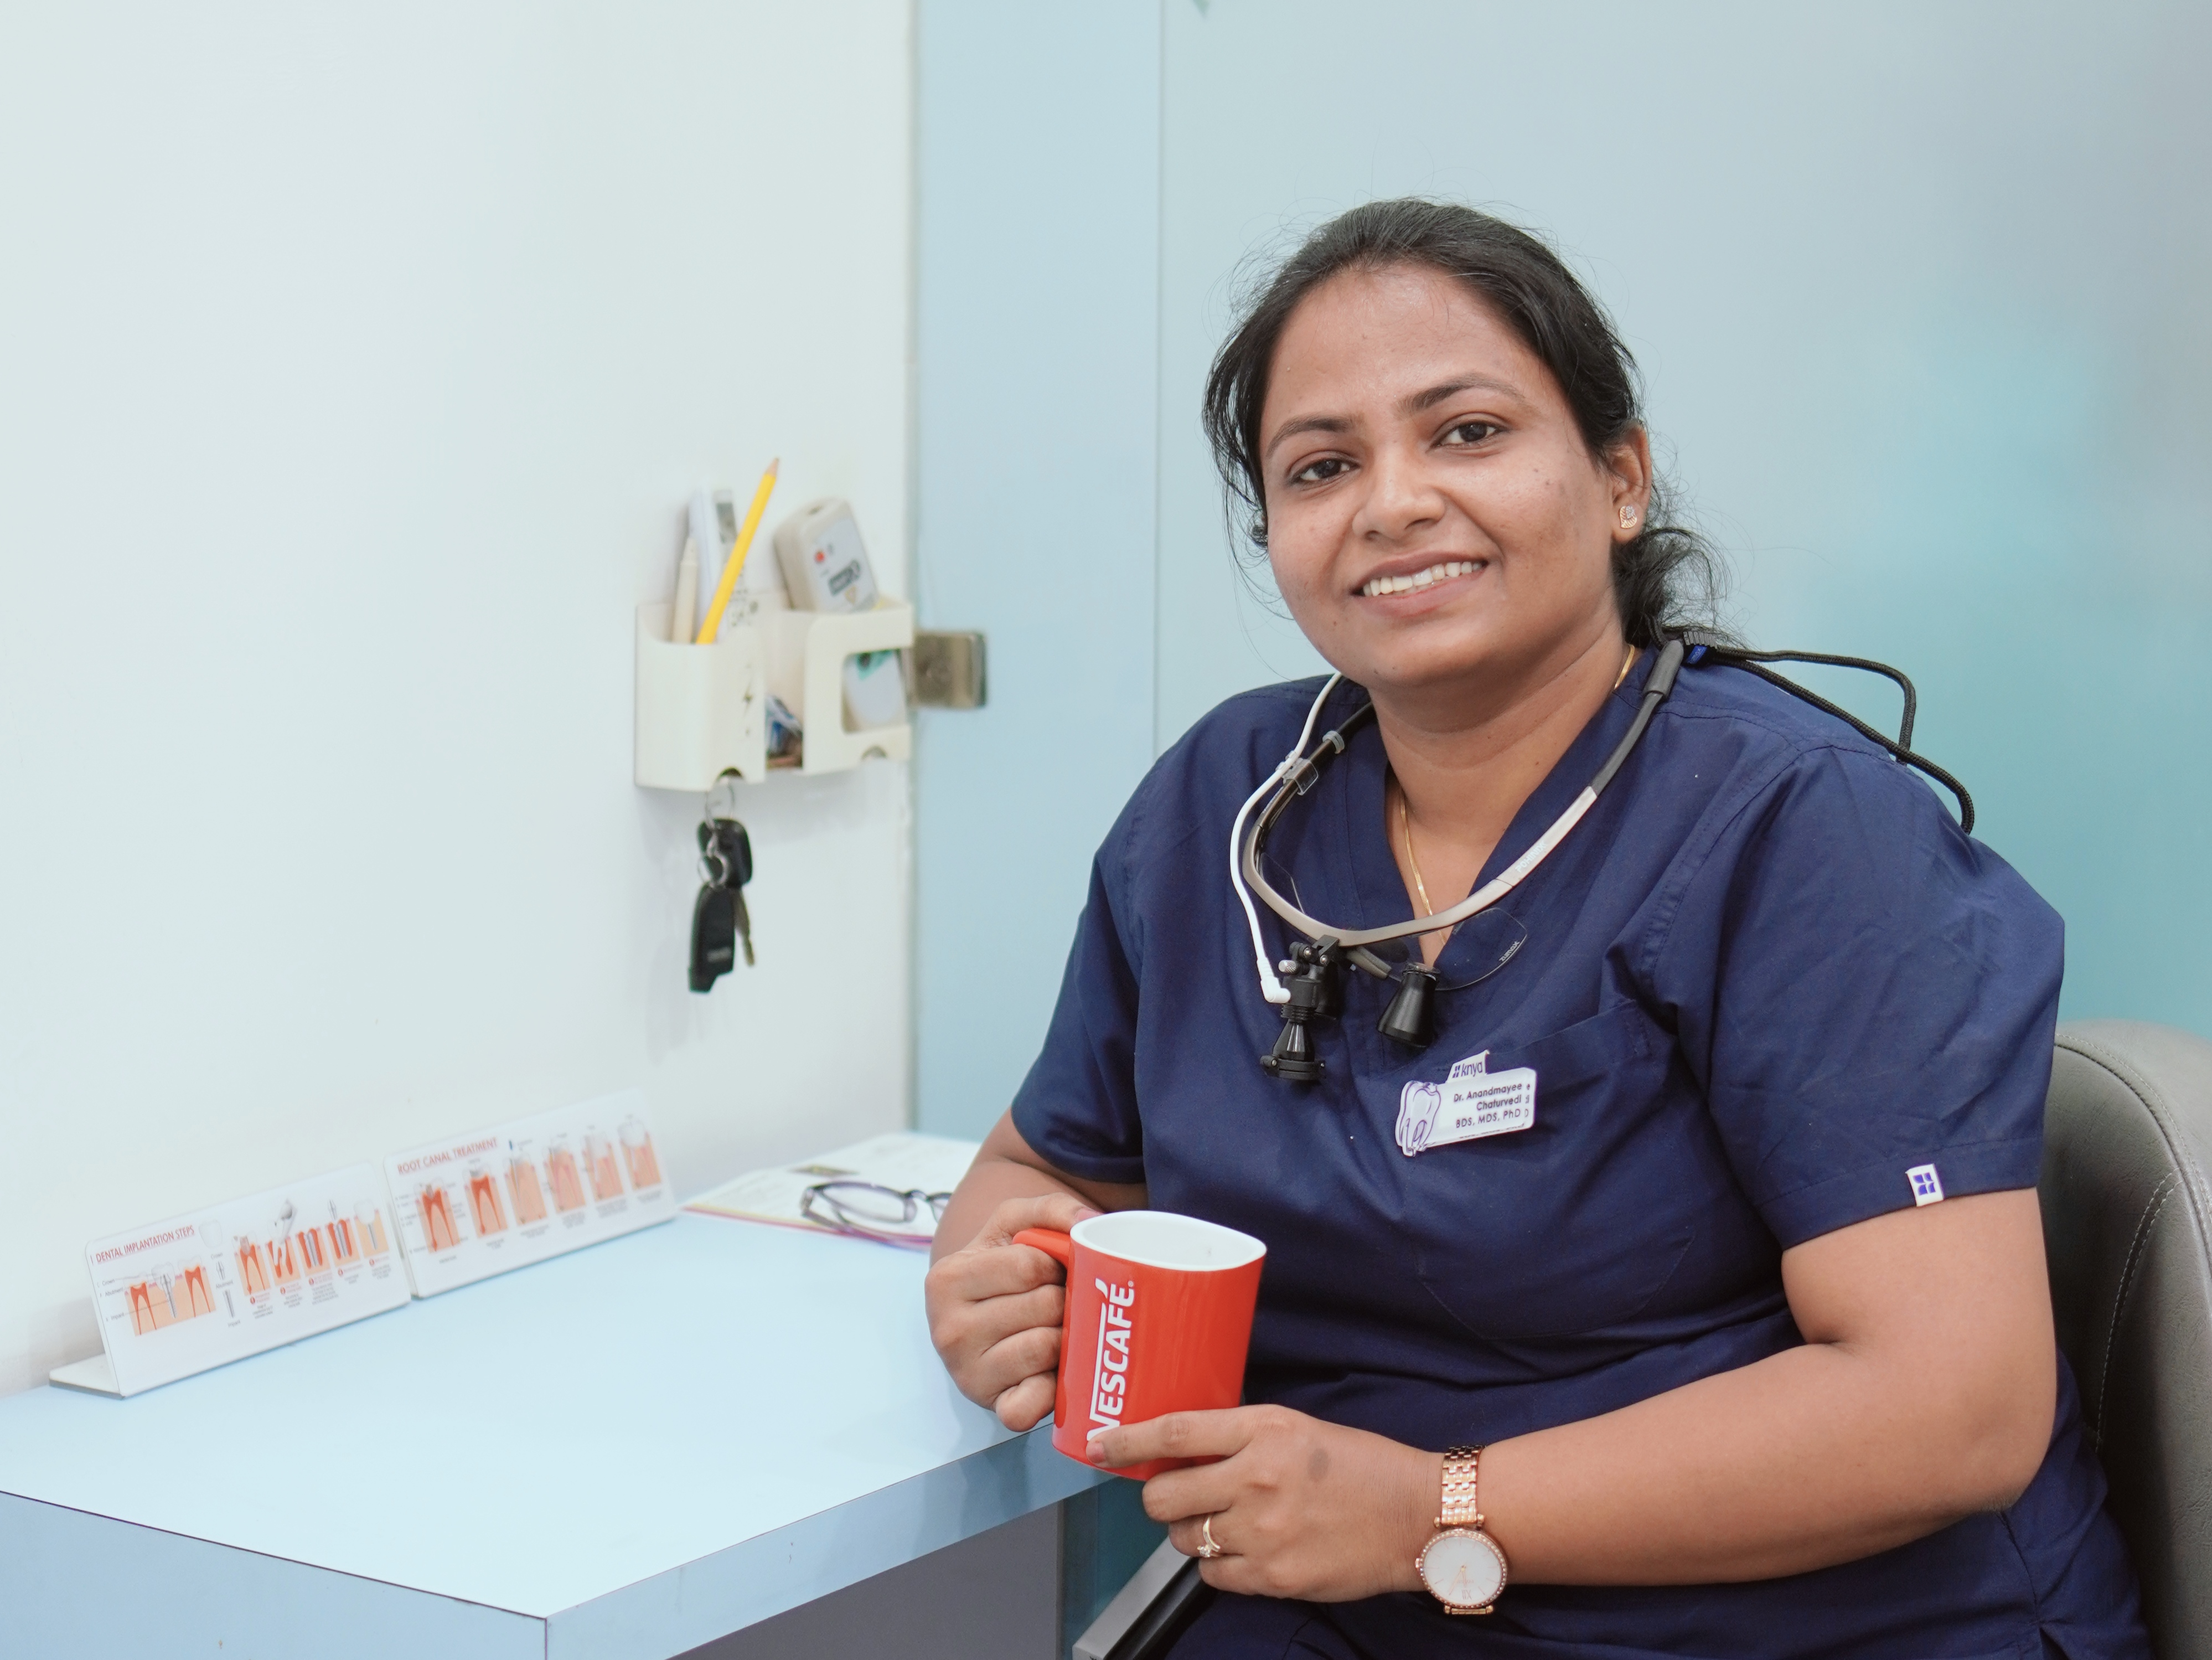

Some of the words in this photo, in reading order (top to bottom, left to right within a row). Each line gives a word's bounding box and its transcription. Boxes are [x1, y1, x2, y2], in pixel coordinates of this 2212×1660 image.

[1461, 1061, 1483, 1077] knya
[1454, 1094, 1464, 1102] Dr.
[1466, 1084, 1522, 1100] Anandmayee
[1456, 1117, 1475, 1128] BDS,
[1478, 1112, 1500, 1124] MDS,
[1503, 1109, 1521, 1120] PhD
[397, 1158, 421, 1174] ROOT
[423, 1151, 452, 1167] CANAL
[452, 1137, 498, 1158] TREATMENT
[96, 1246, 123, 1263] DENTAL
[123, 1231, 174, 1254] IMPLANTATION
[175, 1225, 194, 1239] STEPS
